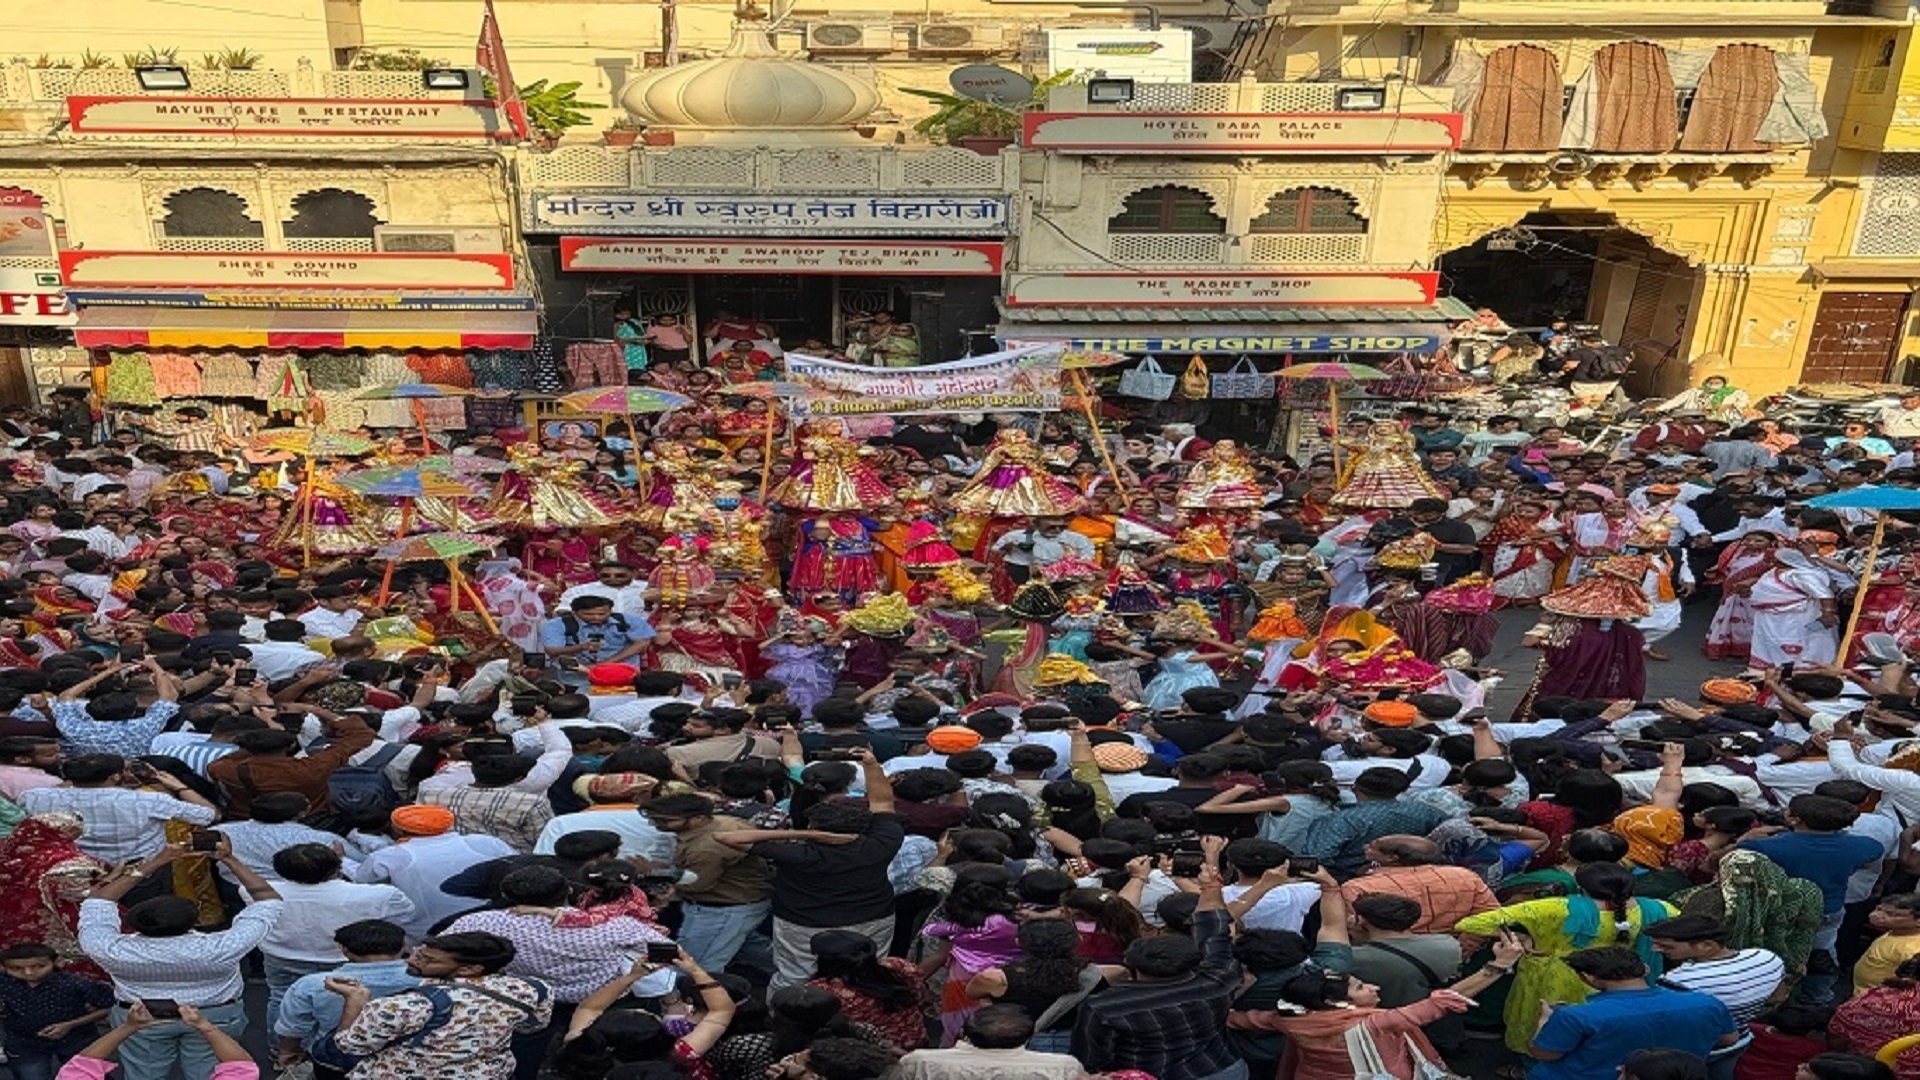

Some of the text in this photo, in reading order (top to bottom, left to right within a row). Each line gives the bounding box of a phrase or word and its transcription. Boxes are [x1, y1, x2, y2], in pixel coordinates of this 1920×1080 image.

[156, 105, 440, 116] MAYUR CAFE & RESTAURANT
[1144, 121, 1343, 130] HOTEL BABA PALACE
[647, 198, 684, 216] श्री
[805, 199, 857, 218] तेज
[599, 246, 664, 254] MANDIR
[674, 247, 729, 255] SHREE
[744, 248, 825, 256] SWAROOP
[838, 249, 870, 257] TEJ
[218, 261, 358, 269] SHREE GOVIND
[1183, 281, 1253, 289] MAGNET
[1079, 340, 1149, 350] THE
[1162, 338, 1318, 350] MAGNET
[1329, 337, 1429, 350] SHOP
